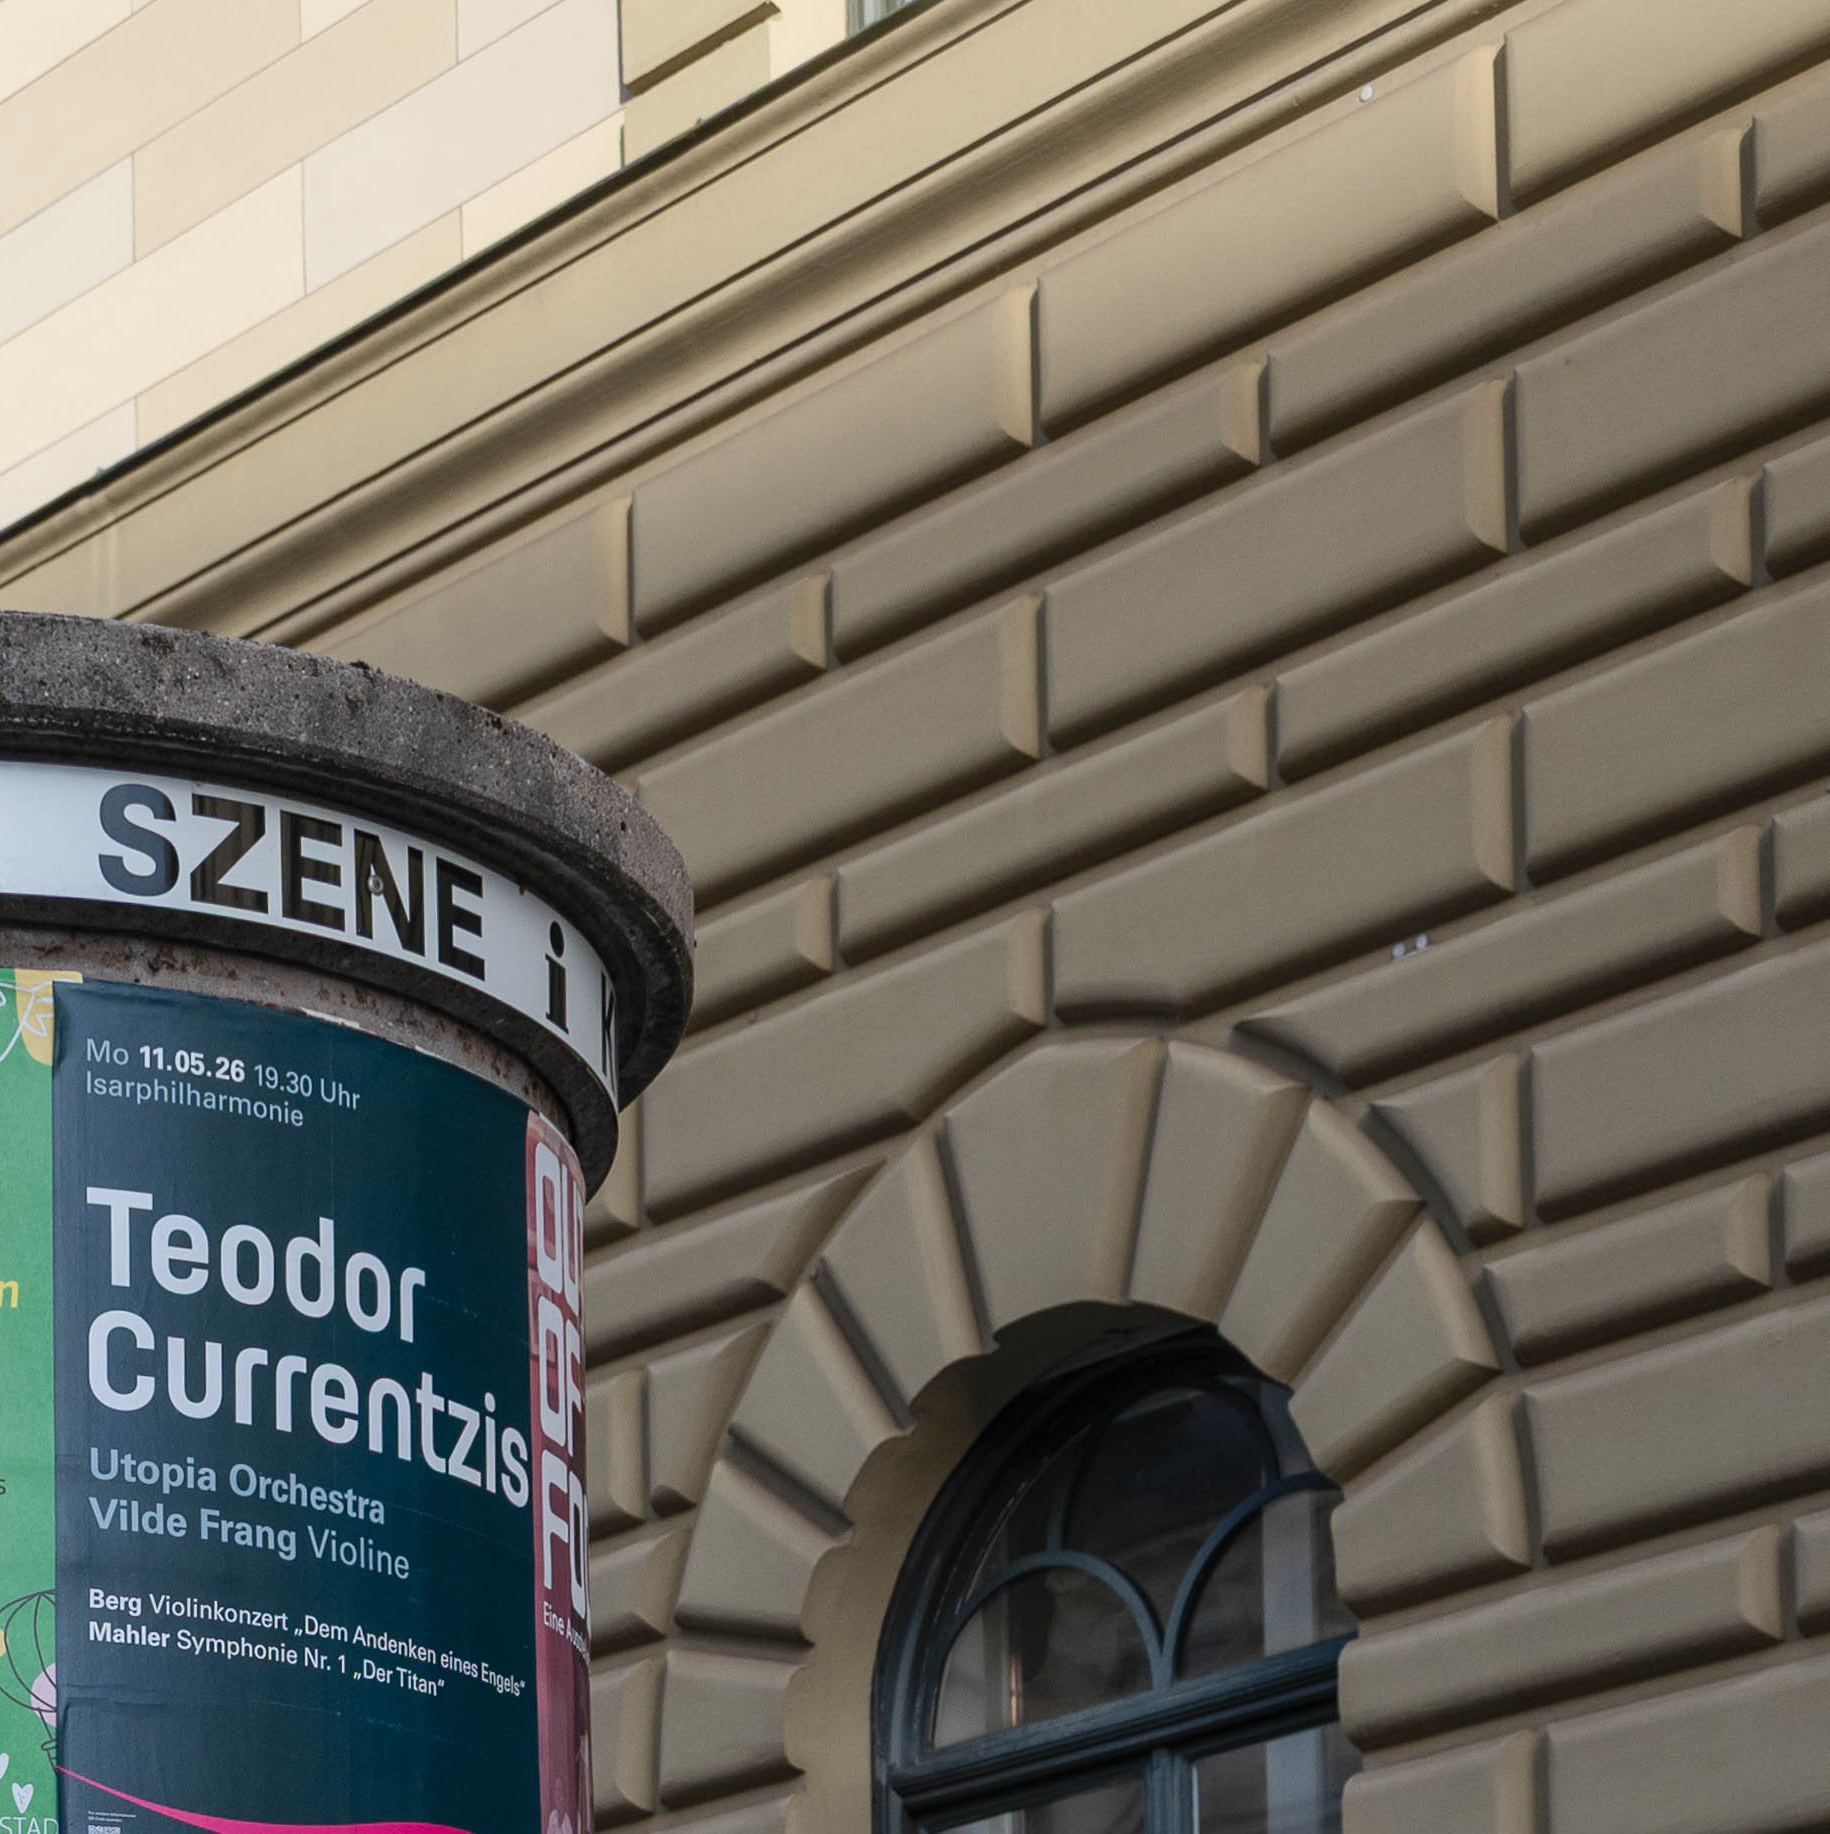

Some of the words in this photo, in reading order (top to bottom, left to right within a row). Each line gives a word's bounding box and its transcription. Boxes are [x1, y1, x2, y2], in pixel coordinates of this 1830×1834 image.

[98, 781, 485, 981] SZENE
[86, 1038, 129, 1067] Mo
[140, 1045, 245, 1083] 11.05.26
[254, 1064, 313, 1098] 19.30
[320, 1078, 360, 1110] Uhr
[86, 1071, 304, 1128] Isarphilharmonie
[86, 1186, 426, 1343] Teodor
[88, 1309, 529, 1508] Currentzis
[89, 1447, 217, 1493] Utopia
[229, 1463, 385, 1525] Orchestra
[89, 1497, 187, 1537] Vilde
[200, 1508, 297, 1561] Frang
[307, 1525, 410, 1580] Violine
[89, 1588, 142, 1617] Berg
[149, 1593, 288, 1633] Violinkonzert
[353, 1627, 436, 1665] Andenken
[440, 1652, 478, 1679] eines
